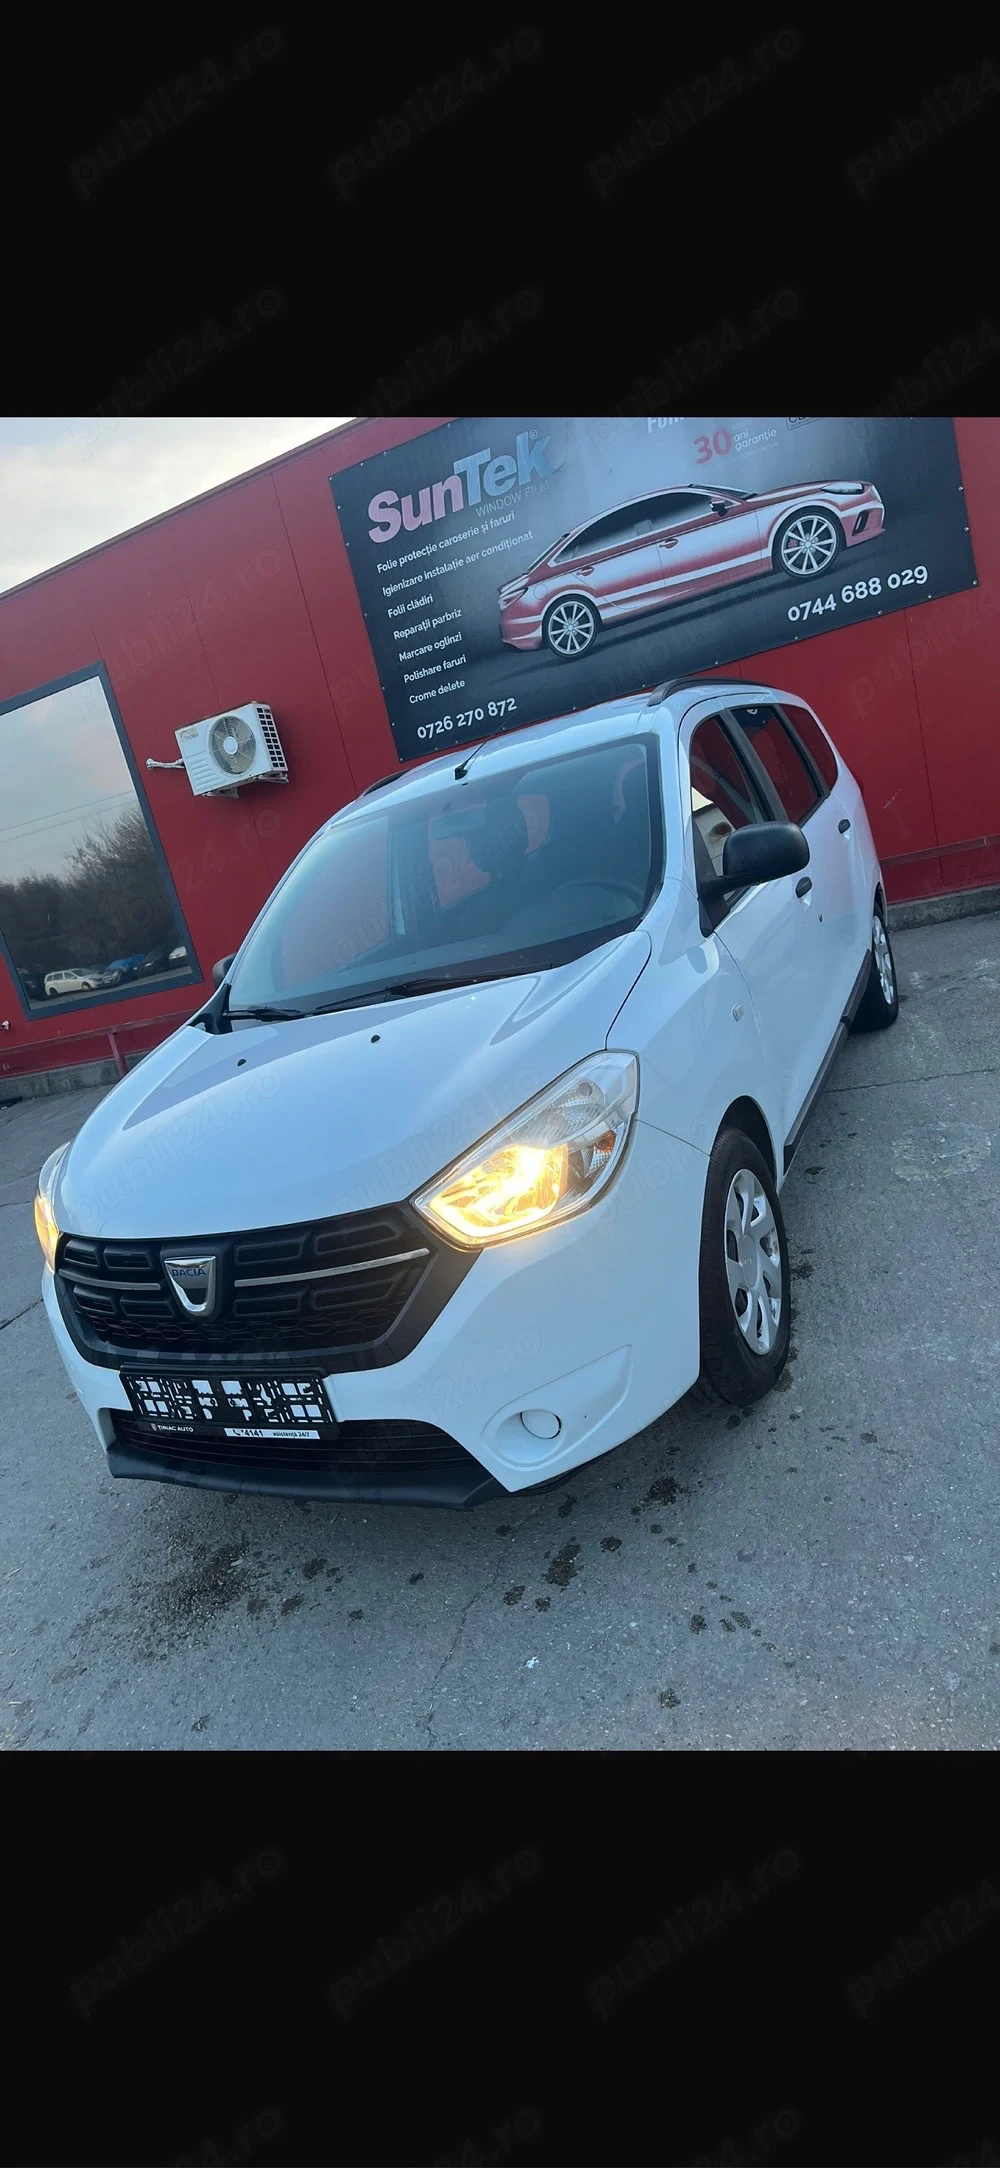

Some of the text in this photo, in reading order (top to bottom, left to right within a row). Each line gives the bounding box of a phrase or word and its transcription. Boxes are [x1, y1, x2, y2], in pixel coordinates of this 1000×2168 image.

[693, 428, 732, 464] 30
[733, 428, 749, 442] ani
[367, 431, 550, 544] SunTek
[475, 491, 522, 517] WINDOW
[377, 559, 397, 573] Folie
[399, 544, 437, 567] protecție
[439, 526, 479, 549] caroserie
[490, 511, 515, 529] faruri
[382, 574, 423, 597] Igienizare
[465, 552, 480, 564] aer
[387, 593, 434, 618] Folii clădiri
[787, 565, 928, 622] 0744 688 029
[432, 609, 462, 628] parbriz
[399, 631, 462, 661] Marcare oglinzi
[403, 654, 467, 683] Polishare faruri
[409, 680, 466, 704] Crome delete
[417, 698, 517, 739] 0726 270 872
[172, 1268, 207, 1277] DACIA
